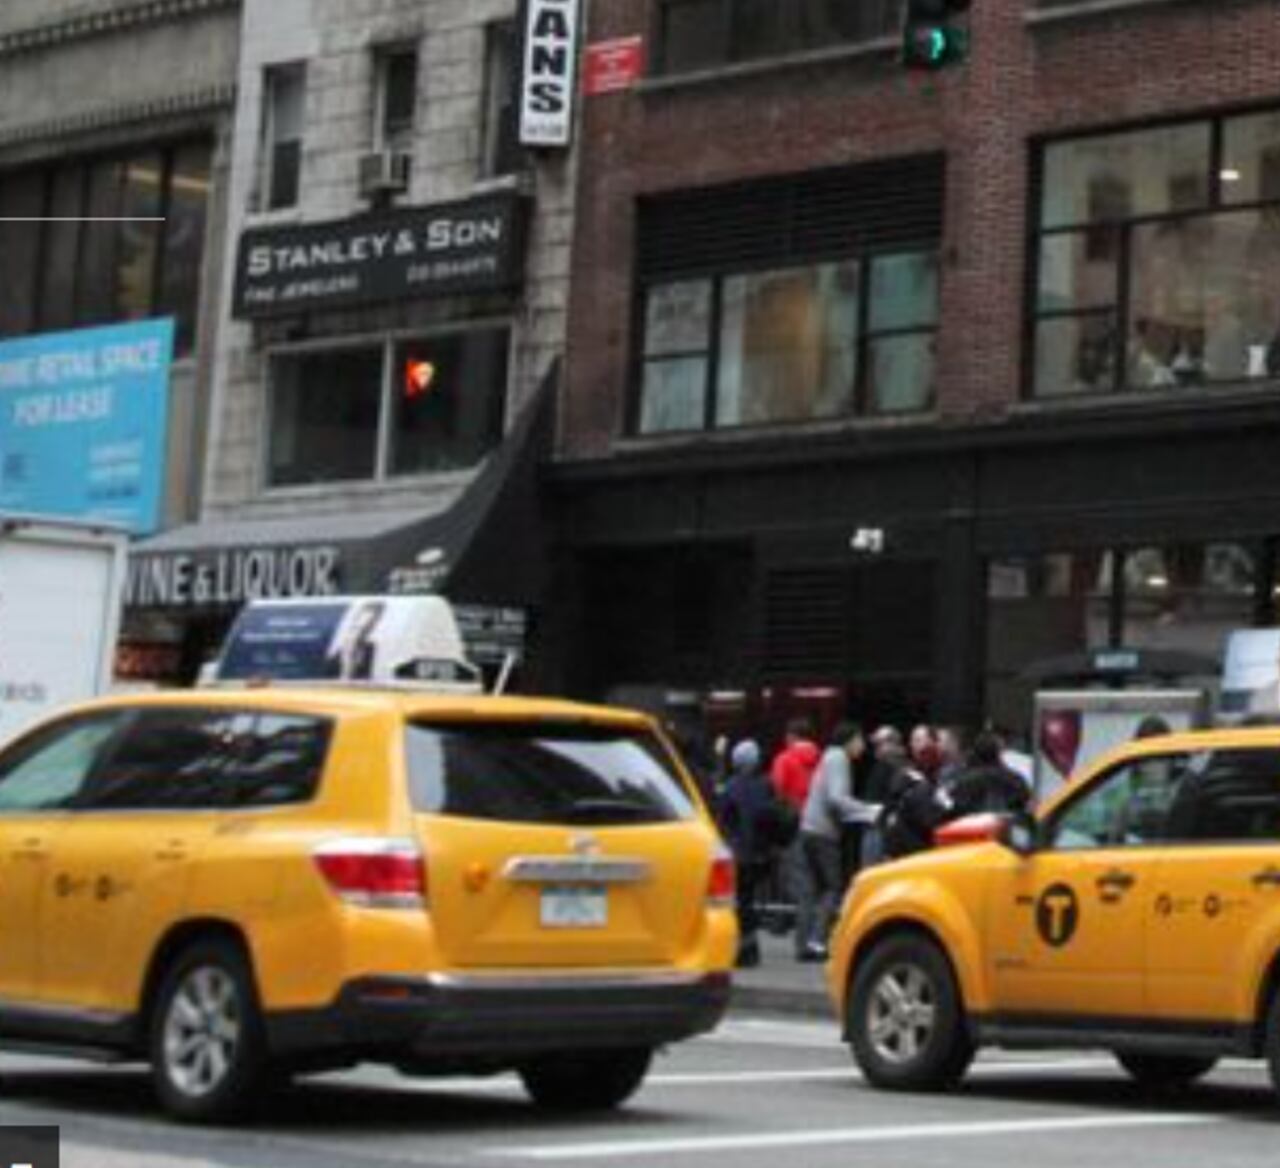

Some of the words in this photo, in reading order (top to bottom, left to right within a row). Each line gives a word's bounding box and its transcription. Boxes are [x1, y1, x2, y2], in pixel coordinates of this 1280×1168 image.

[247, 233, 392, 276] STANLEY
[394, 230, 415, 255] &
[426, 218, 501, 250] SON
[218, 548, 338, 601] LIQUOR
